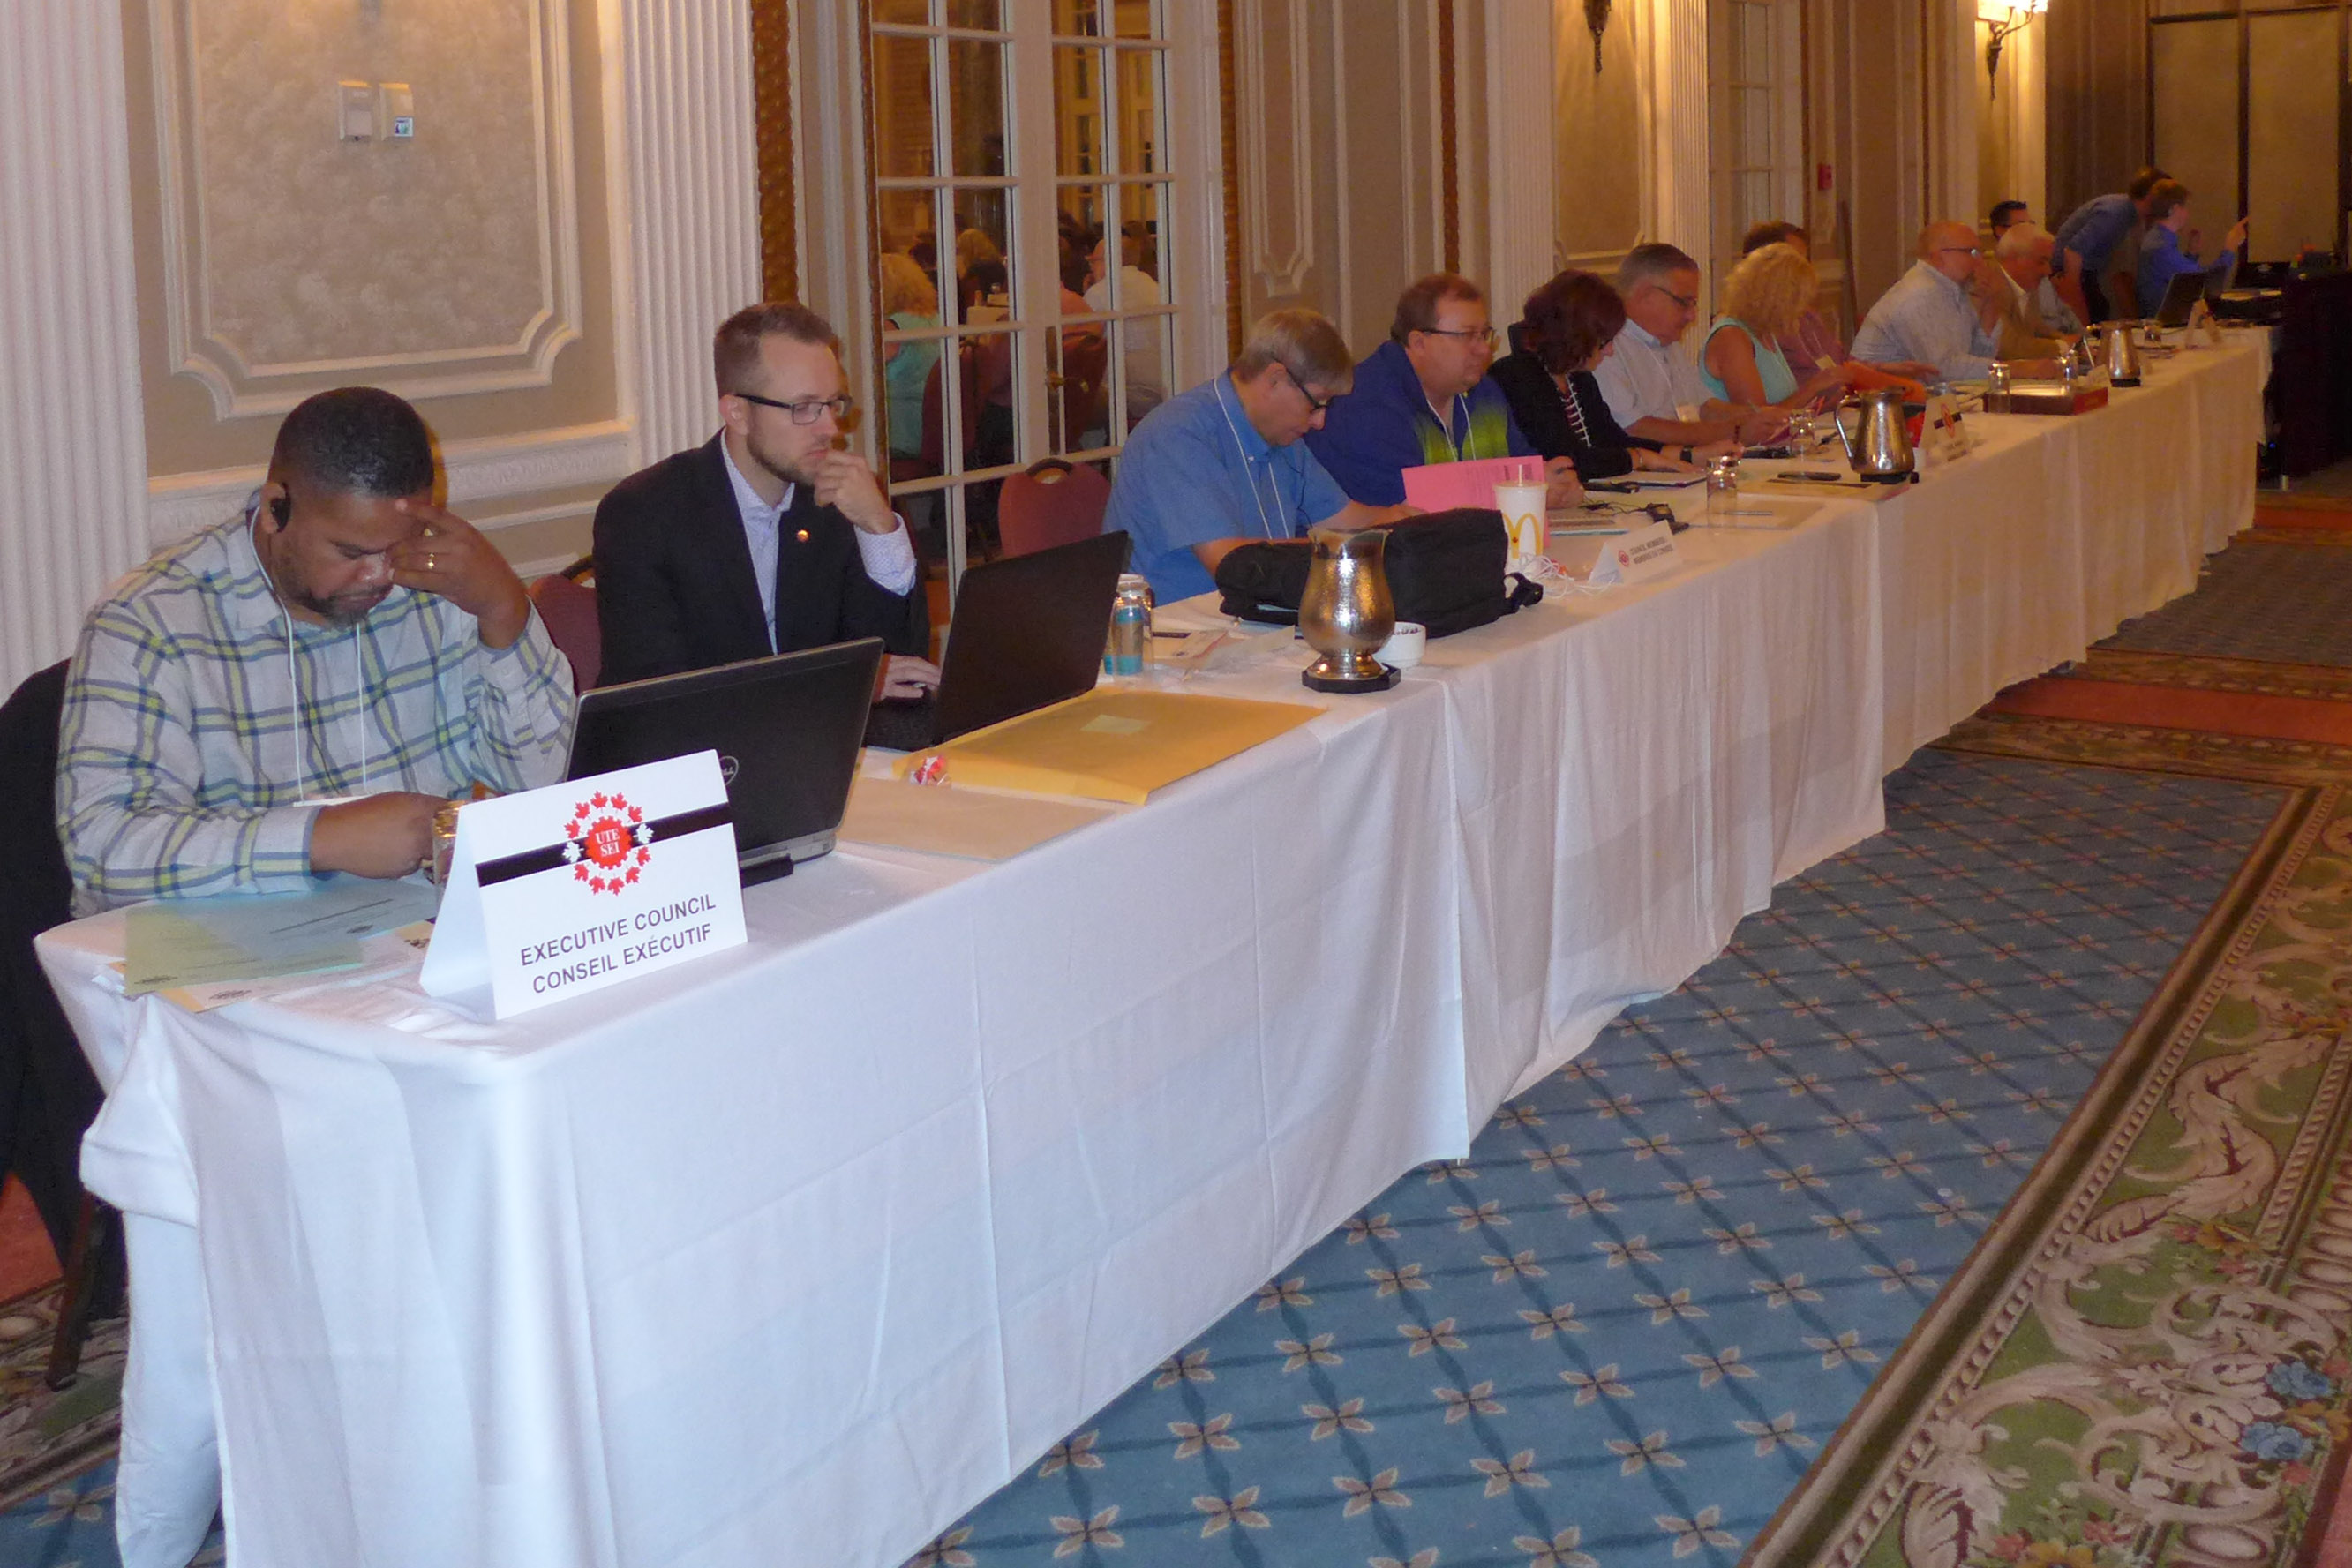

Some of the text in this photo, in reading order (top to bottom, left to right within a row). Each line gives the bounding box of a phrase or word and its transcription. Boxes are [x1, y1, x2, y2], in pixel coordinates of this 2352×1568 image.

[595, 828, 620, 844] UTE
[600, 842, 620, 857] SEI
[521, 894, 716, 966] EXECUTIVE COUNCIL
[533, 923, 711, 994] CONSEIL EXÉCUTIF
